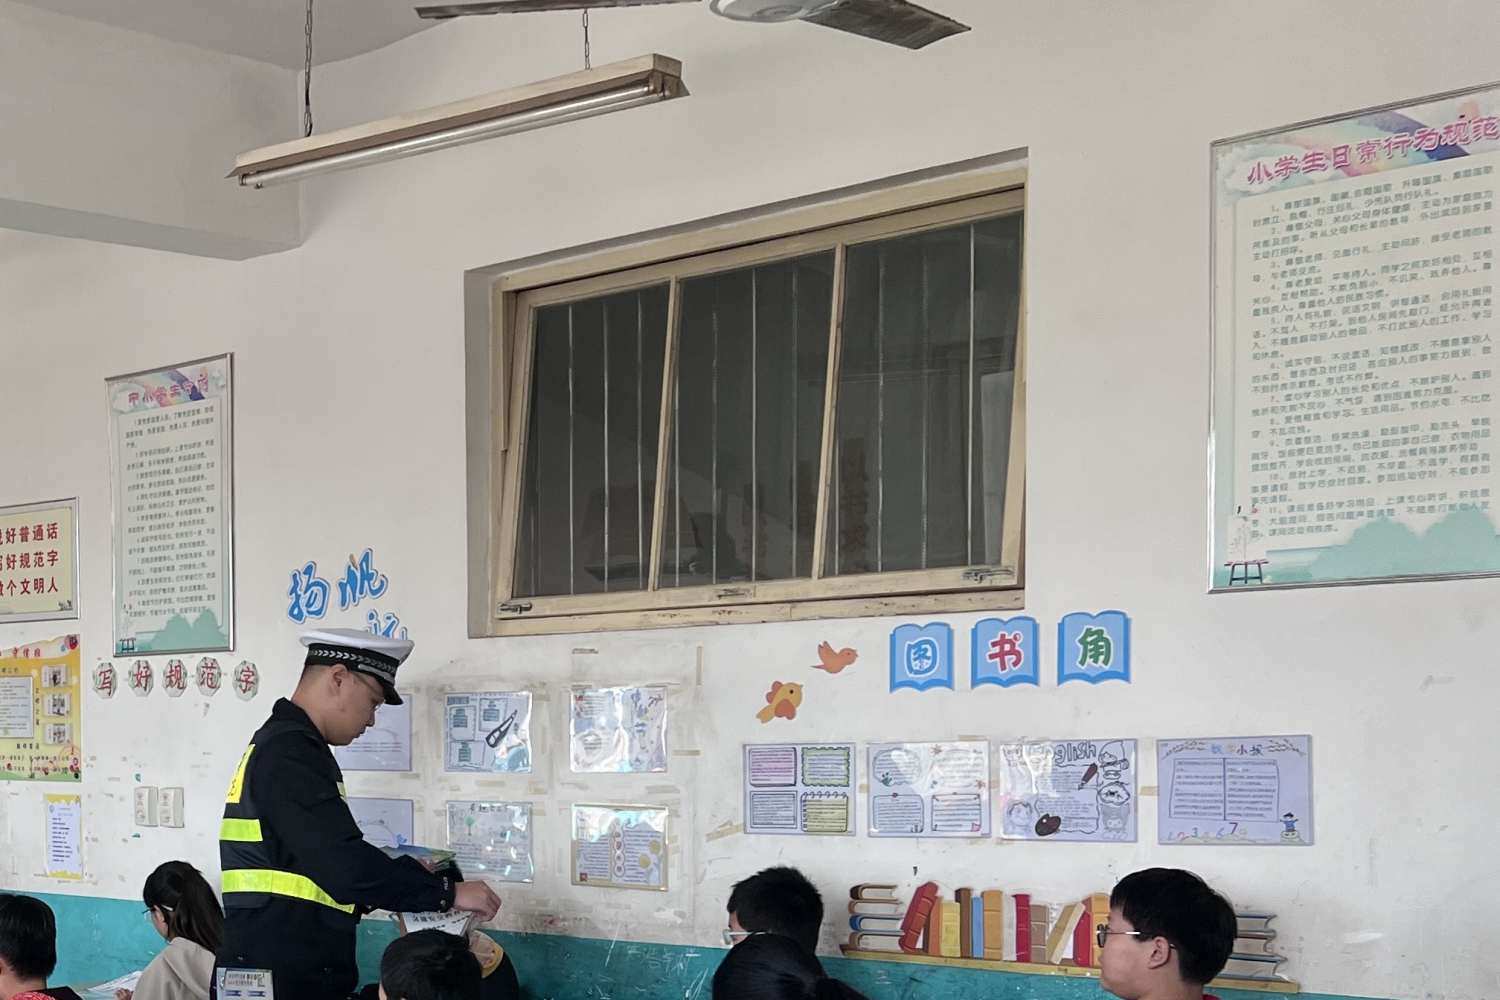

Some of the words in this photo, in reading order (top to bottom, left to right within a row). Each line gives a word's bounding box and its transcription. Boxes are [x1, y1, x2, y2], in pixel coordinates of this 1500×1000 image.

[1247, 115, 1500, 184] 小学生日常行为规范
[906, 627, 1113, 675] 图书角
[98, 663, 255, 696] 写好规范字
